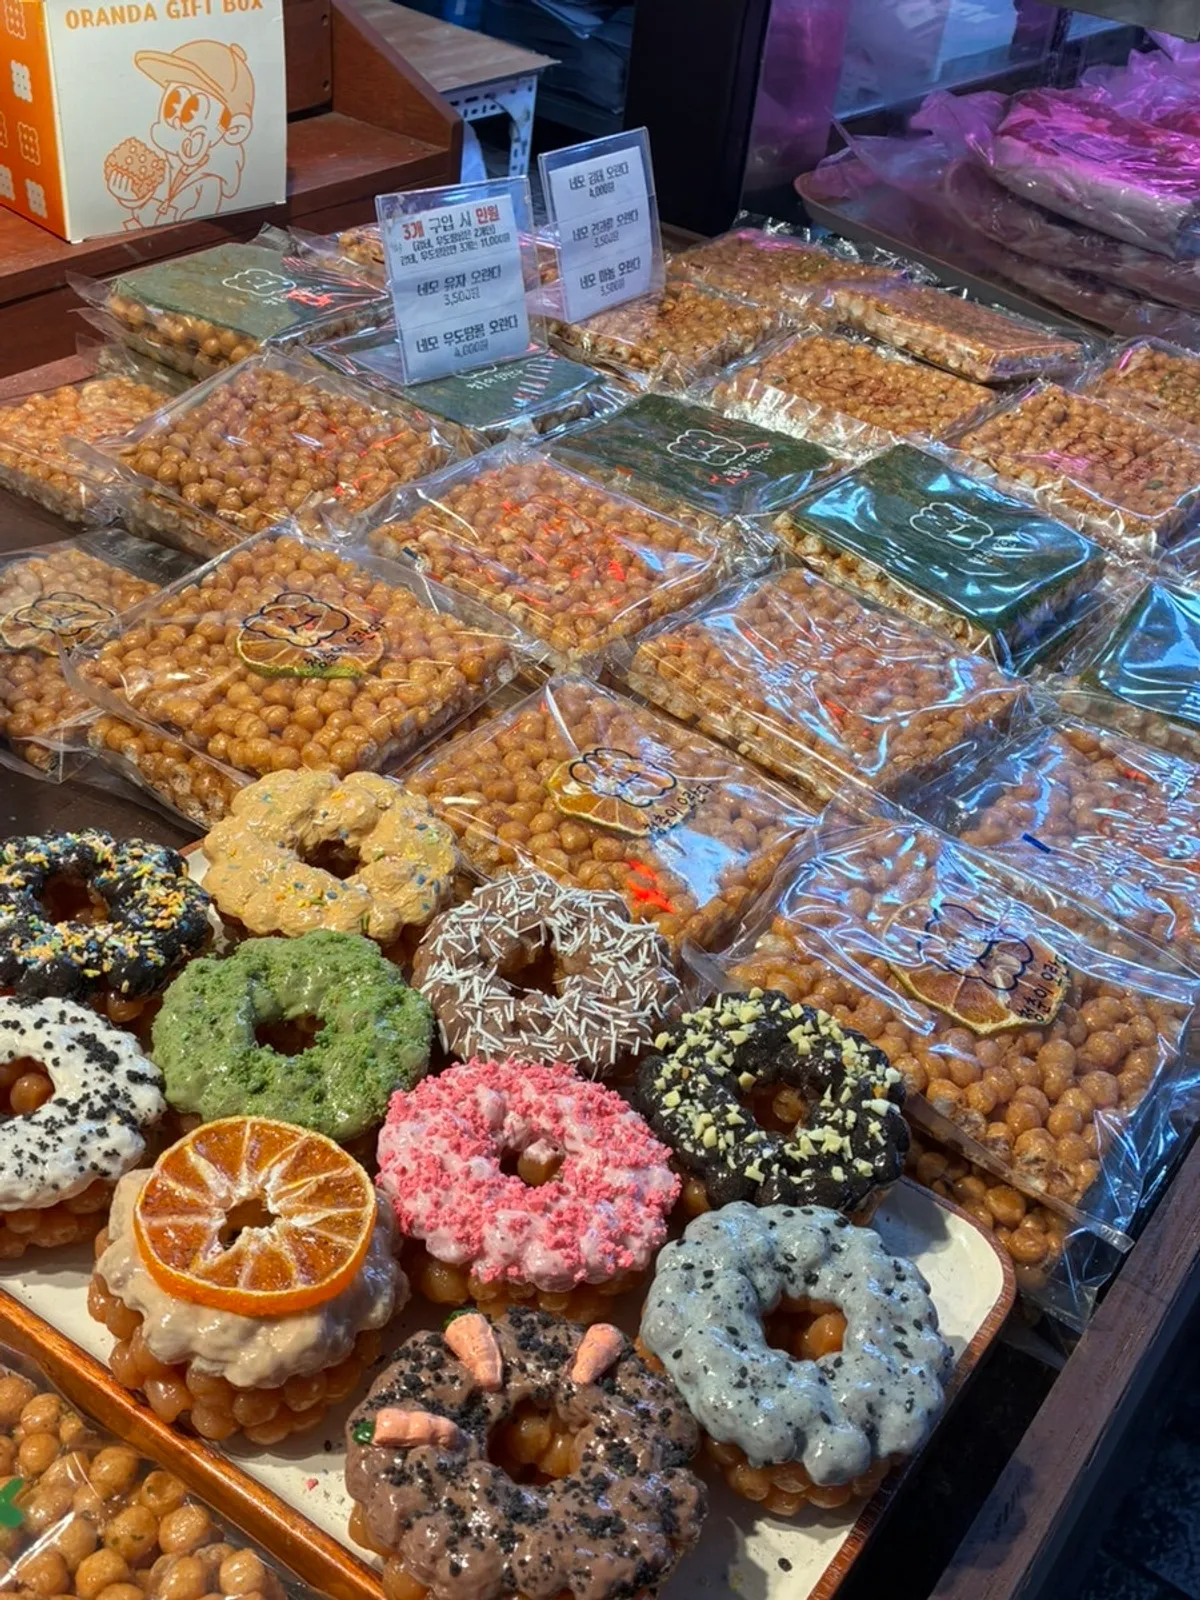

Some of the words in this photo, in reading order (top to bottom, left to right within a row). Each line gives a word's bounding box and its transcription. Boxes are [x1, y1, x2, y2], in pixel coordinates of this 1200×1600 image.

[64, 3, 158, 29] ORANDA
[166, 0, 211, 19] GIFT
[568, 174, 585, 191] 네모
[606, 161, 629, 179] 오란다
[589, 181, 615, 199] 4,000원
[402, 220, 425, 241] 3개
[428, 214, 455, 233] 구입
[460, 211, 472, 228] 시
[475, 204, 500, 225] 만원
[572, 225, 589, 242] 네모
[616, 208, 639, 228] 오란다
[481, 232, 511, 248] 11,000원
[593, 230, 620, 249] 3,500원
[417, 280, 439, 296] 네모
[444, 273, 467, 291] 유자
[471, 264, 502, 285] 오란다
[580, 273, 596, 290] 네모
[598, 268, 616, 284] 마늘
[618, 256, 641, 276] 오란다
[600, 278, 625, 297] 3,500원
[444, 286, 481, 306] 3,500원
[416, 336, 440, 353] 네모
[443, 323, 485, 346] 우도땅콩
[489, 314, 519, 335] 오란다
[454, 339, 489, 358] 4,000원
